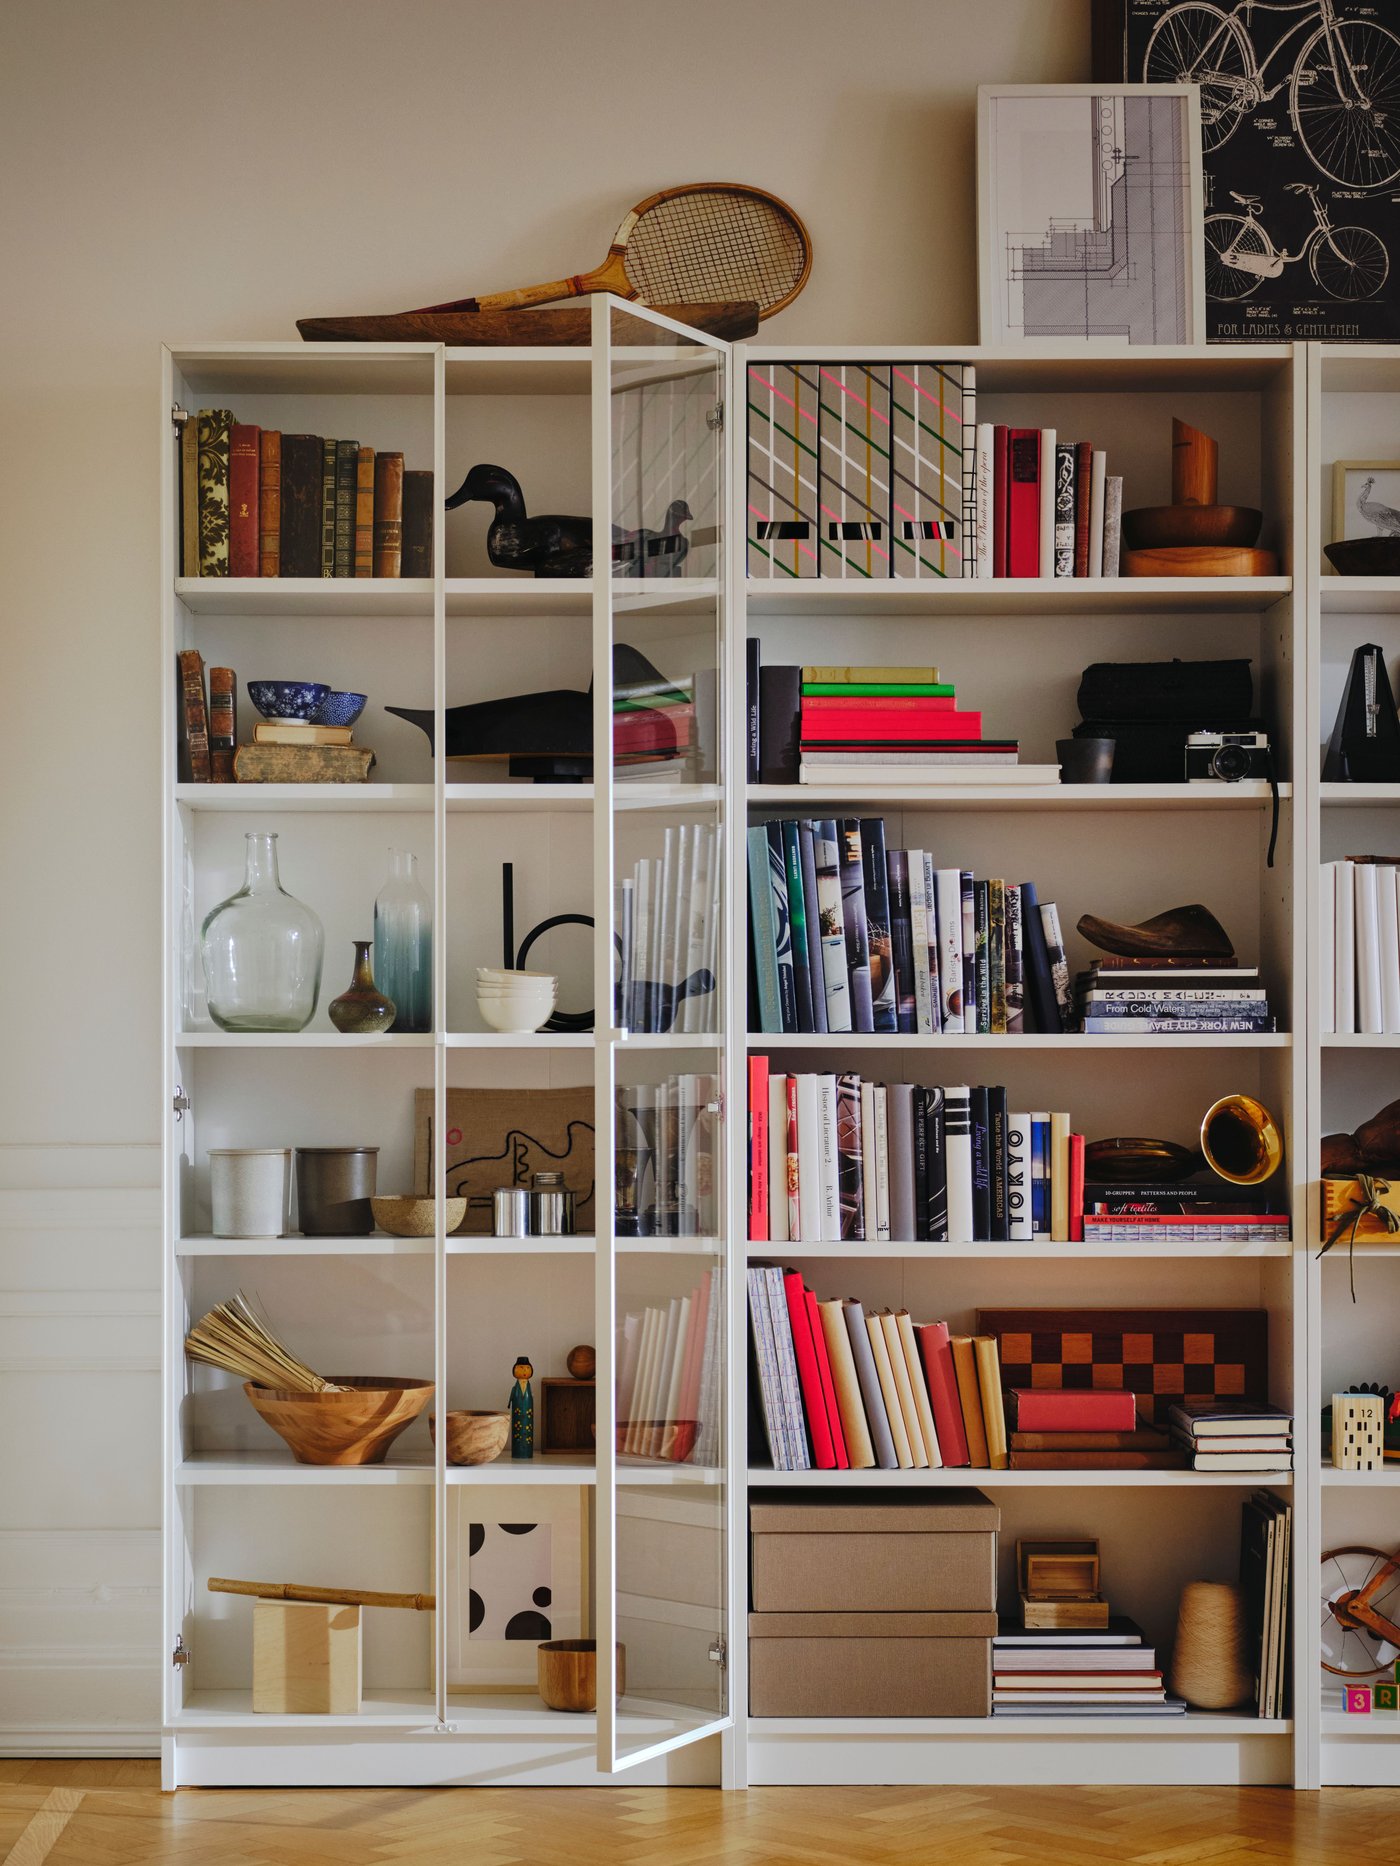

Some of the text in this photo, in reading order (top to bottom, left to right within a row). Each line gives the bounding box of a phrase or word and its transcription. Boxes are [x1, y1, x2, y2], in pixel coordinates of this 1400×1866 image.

[1218, 324, 1360, 336] FOR LADIES & GENTLEMEN
[980, 452, 991, 474] opera
[978, 476, 987, 488] the
[980, 487, 988, 497] of
[976, 499, 988, 540] Phantom
[1130, 1004, 1152, 1012] Cold
[1154, 1004, 1185, 1012] Waters
[1174, 1022, 1198, 1030] CITY
[1200, 1022, 1228, 1030] YORK
[1230, 1022, 1253, 1030] NEW
[824, 1114, 830, 1122] of
[976, 1122, 987, 1150] Living
[976, 1160, 988, 1177] wild
[975, 1178, 988, 1190] life
[1008, 1130, 1024, 1226] TOKYO
[826, 1185, 832, 1193] B.
[1112, 1202, 1158, 1215] soft textiles
[1361, 1409, 1373, 1418] 12
[1354, 1694, 1365, 1710] 3
[1380, 1690, 1392, 1704] R
